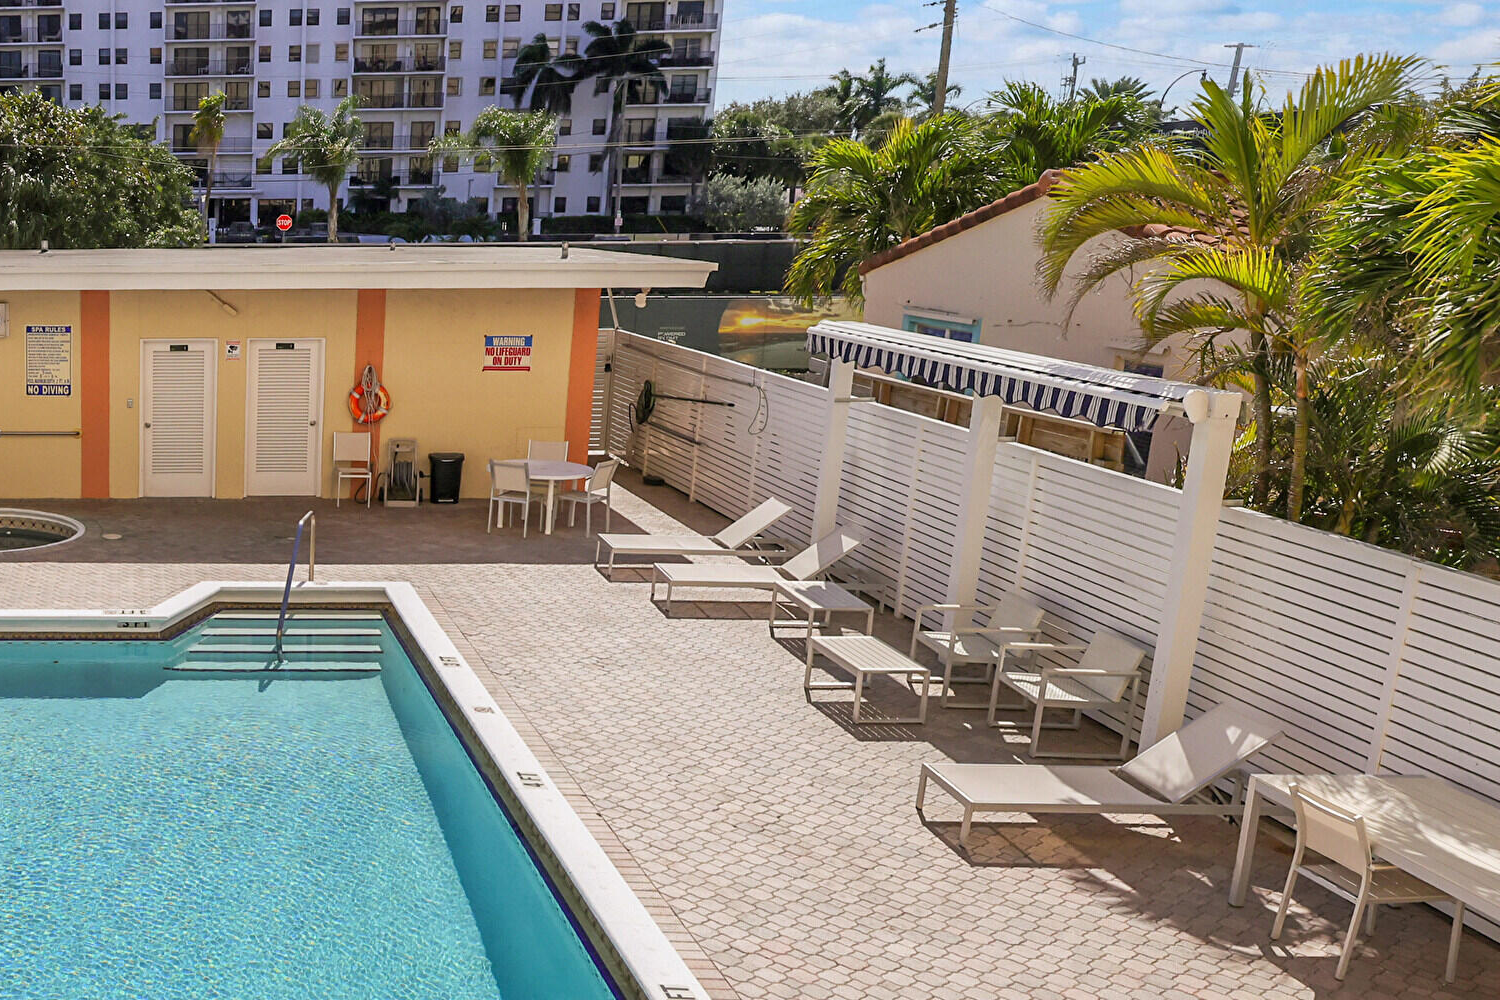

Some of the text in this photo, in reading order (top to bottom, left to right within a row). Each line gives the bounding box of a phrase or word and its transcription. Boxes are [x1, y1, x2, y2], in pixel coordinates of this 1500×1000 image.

[492, 336, 526, 346] WARNING
[485, 347, 531, 356] NO LIFEGUARD
[492, 356, 523, 366] ON DUTY
[27, 385, 69, 395] NO DIVING
[516, 771, 540, 781] FT
[659, 984, 696, 1000] FT
